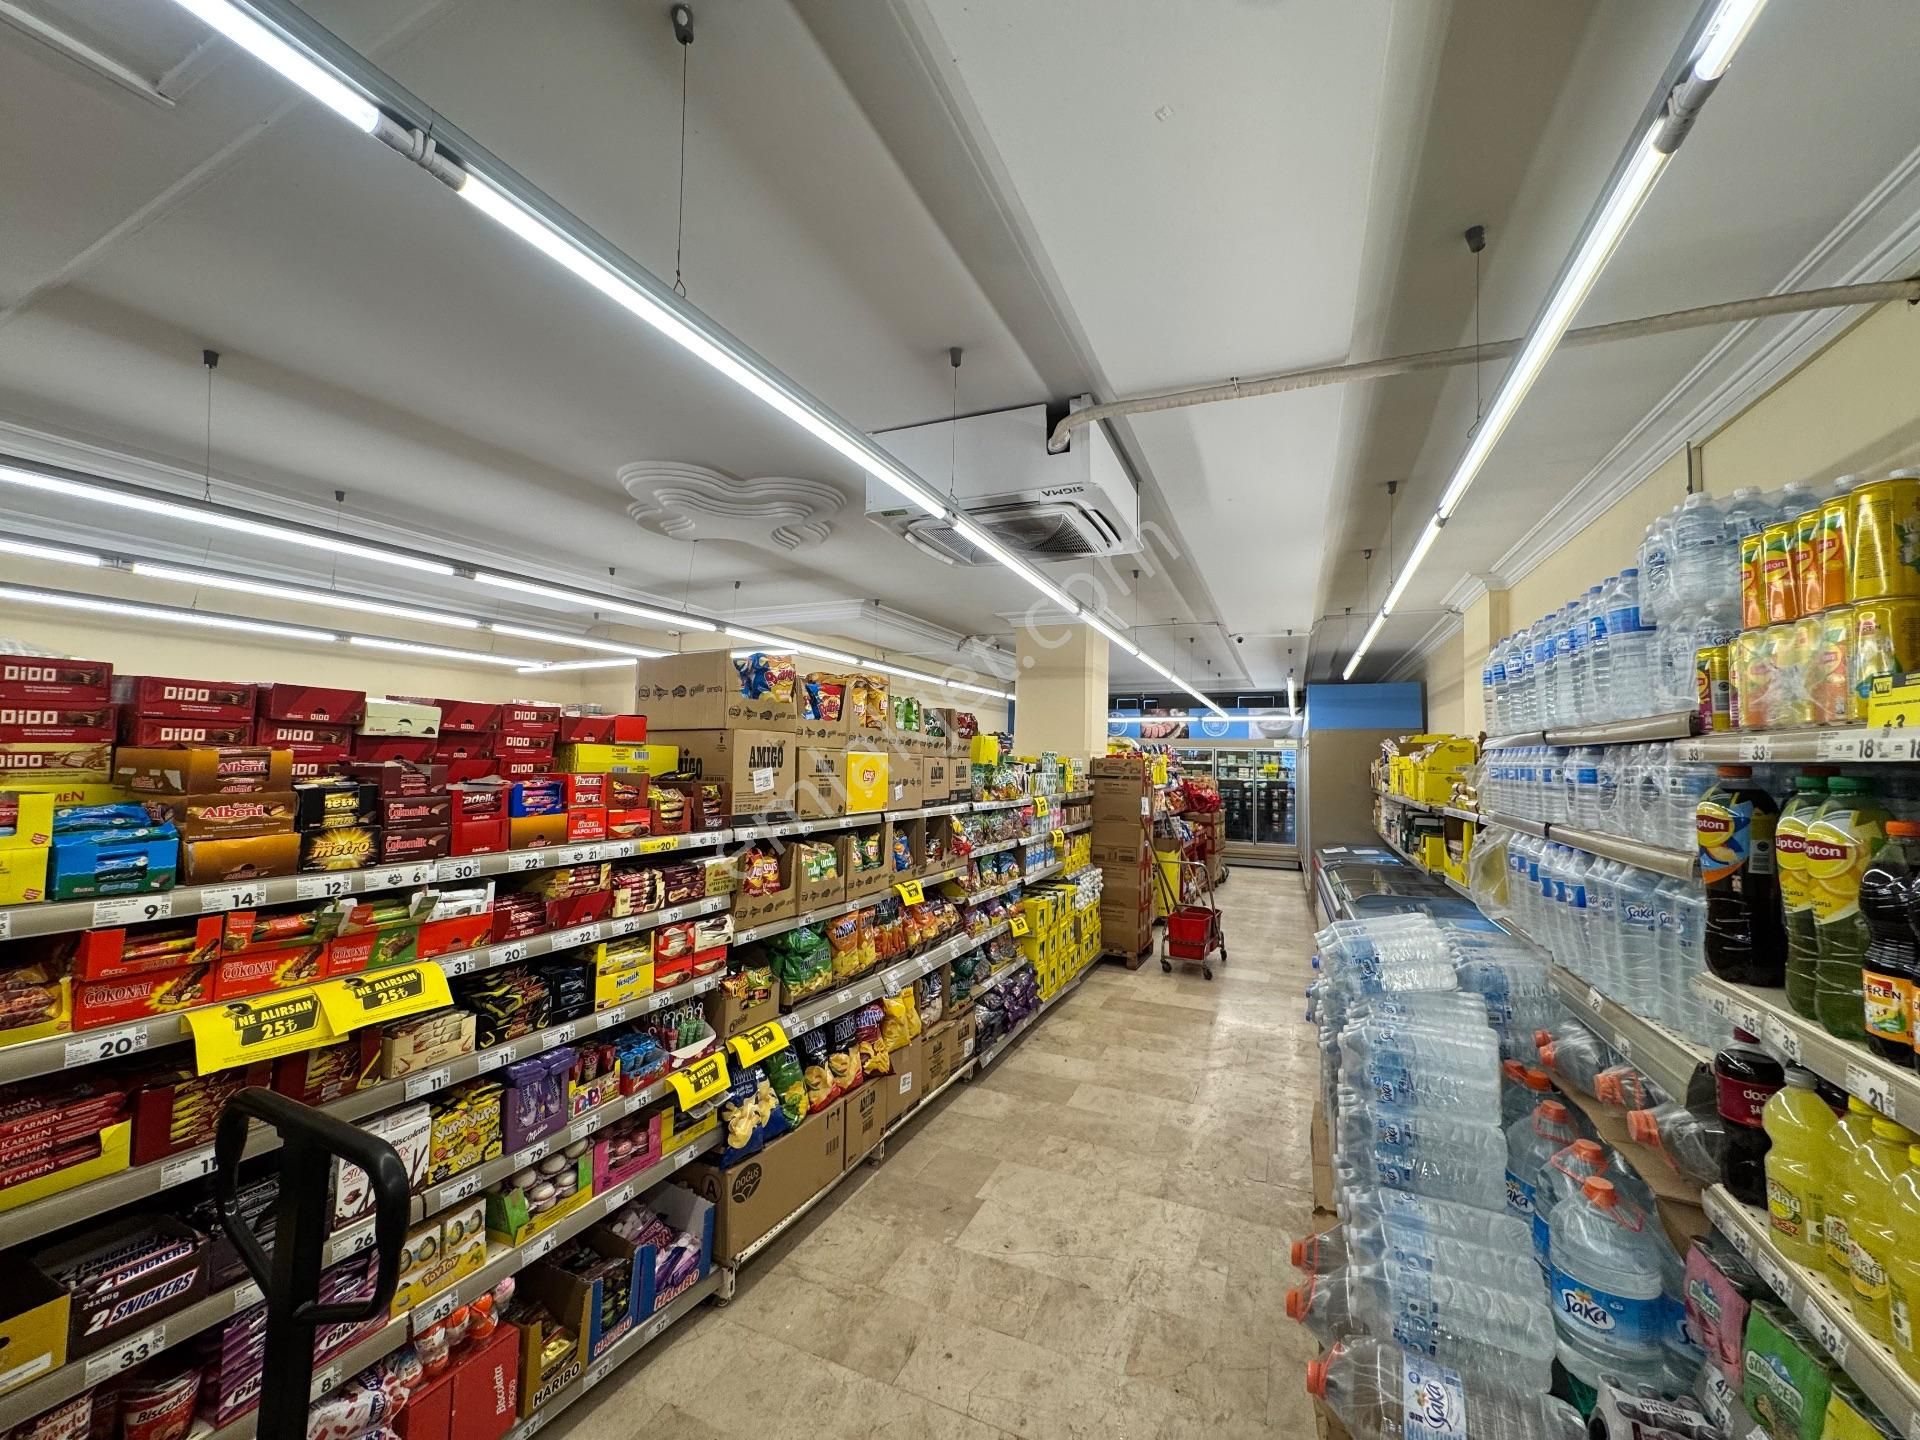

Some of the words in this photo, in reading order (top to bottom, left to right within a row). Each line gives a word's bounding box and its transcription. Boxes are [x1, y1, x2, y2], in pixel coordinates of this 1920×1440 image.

[749, 746, 784, 768] AMIGO
[1689, 748, 1700, 761] 33
[1752, 745, 1766, 761] 33
[1859, 739, 1874, 759] 18
[217, 762, 266, 773] Albeni
[199, 804, 264, 820] Albeni
[1697, 818, 1725, 832] pton
[313, 841, 370, 858] metro
[620, 847, 629, 857] 19
[660, 842, 671, 851] 20
[1808, 844, 1842, 858] pton
[589, 851, 598, 860] 21
[455, 866, 472, 878] 30
[525, 859, 538, 869] 22
[413, 872, 421, 882] 6
[325, 882, 342, 895] 12
[232, 893, 254, 907] 14
[144, 905, 158, 919] 9
[624, 923, 635, 933] 22
[580, 932, 591, 943] 22
[504, 951, 520, 962] 20
[222, 959, 278, 982] ÇOKONAT
[454, 962, 468, 975] 31
[356, 983, 373, 997] NE
[375, 971, 418, 992] ALIRSAN
[616, 970, 640, 989] Nesquik
[84, 982, 154, 1009] ÇOKONAT
[659, 997, 669, 1006] 20
[238, 1011, 257, 1027] NE
[260, 999, 314, 1022] ALIRSAN
[611, 1014, 620, 1024] 12
[1743, 1015, 1755, 1033] 35
[559, 1031, 569, 1042] 21
[100, 1037, 132, 1059] 20
[1783, 1035, 1796, 1055] 35
[499, 1053, 509, 1065] 11
[431, 1077, 442, 1090] 11
[637, 1096, 647, 1106] 13
[13, 1113, 63, 1134] KARMEN
[586, 1120, 596, 1133] 17
[1, 1127, 52, 1149] KARMEN
[1, 1141, 53, 1163] KARMEN
[530, 1149, 543, 1162] 79
[4, 1162, 55, 1186] KARMEN
[457, 1182, 474, 1198] 42
[622, 1190, 629, 1201] 4
[1506, 1187, 1531, 1209] aka
[354, 1234, 375, 1252] 26
[542, 1240, 551, 1253] 4
[1771, 1272, 1786, 1296] 39
[84, 1308, 111, 1337] 2
[112, 1271, 194, 1323] SNICKERS
[1563, 1291, 1609, 1326] Saka
[433, 1305, 451, 1321] 43
[1820, 1324, 1837, 1351] 39
[119, 1343, 150, 1370] 33
[232, 1376, 263, 1405] Pik
[320, 1380, 332, 1394] 8
[533, 1361, 581, 1409] HARIBO
[1423, 1382, 1453, 1432] Saka
